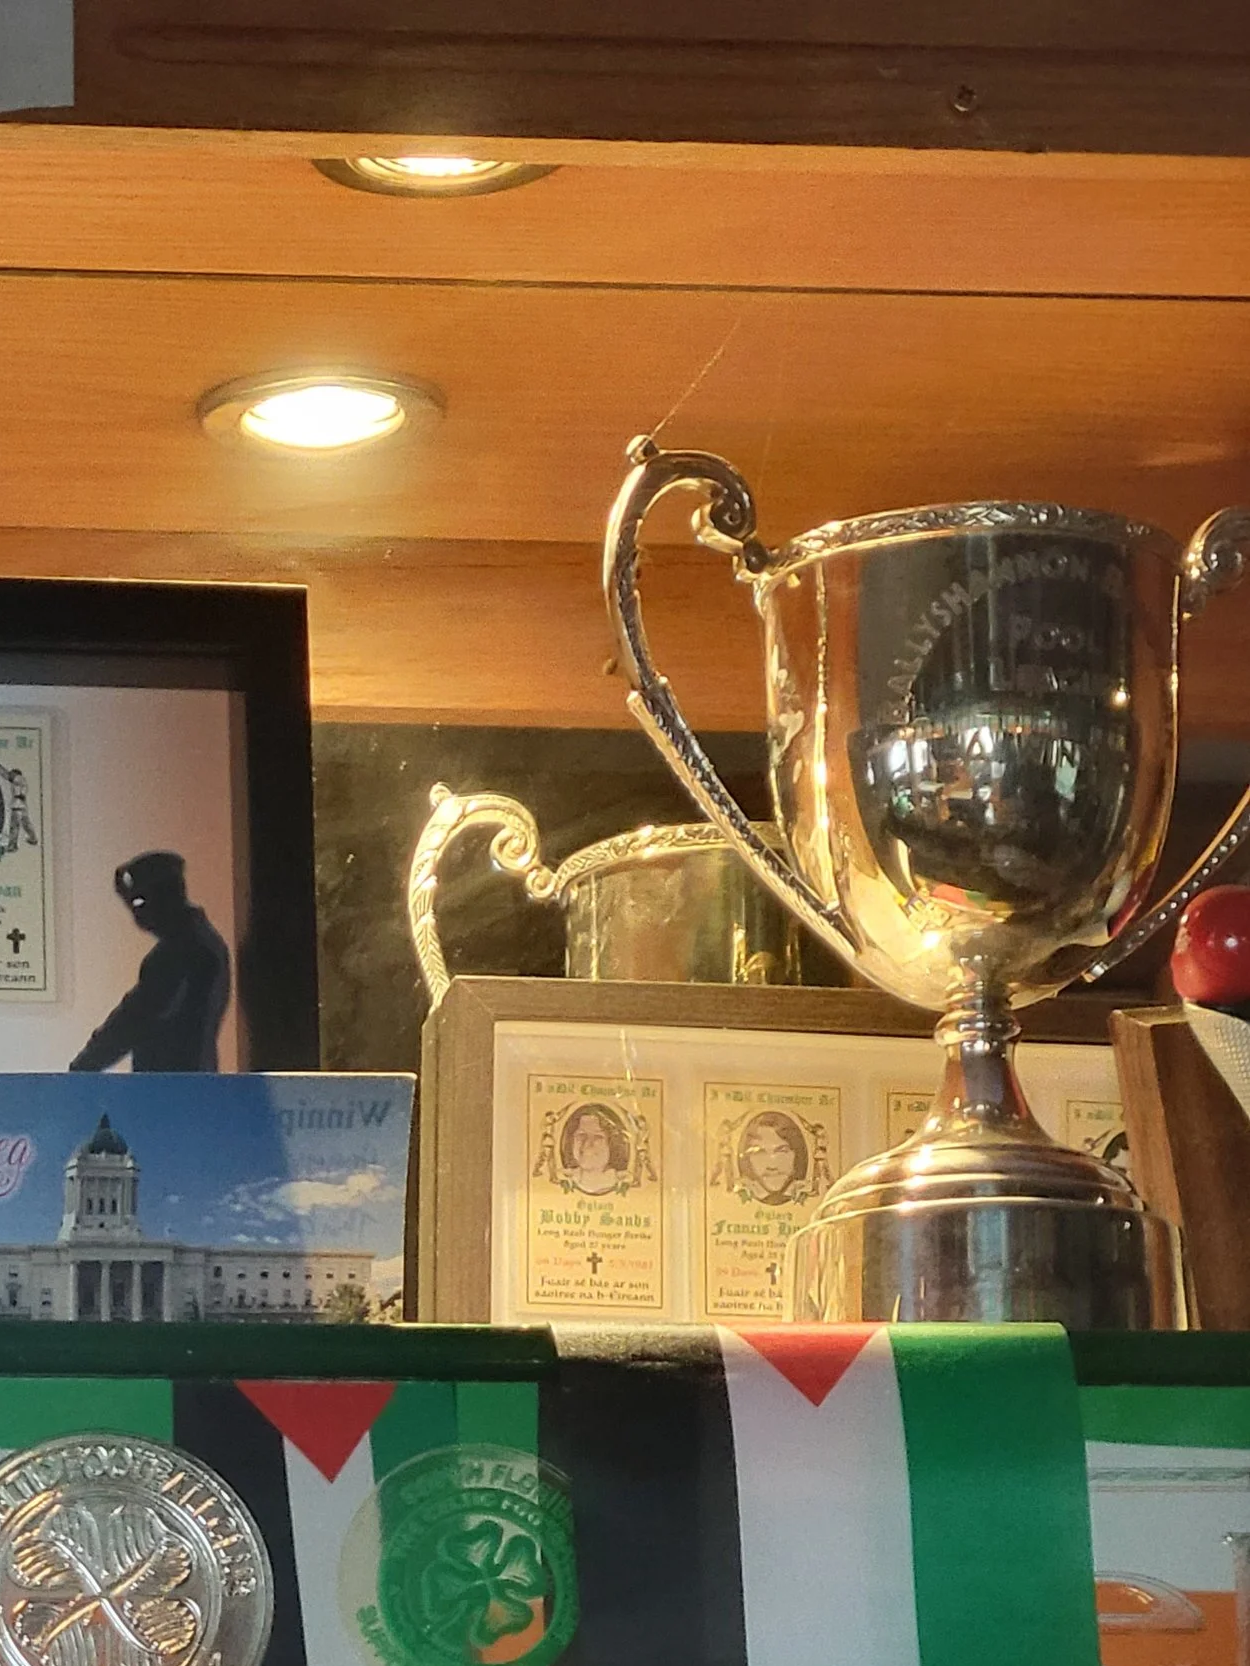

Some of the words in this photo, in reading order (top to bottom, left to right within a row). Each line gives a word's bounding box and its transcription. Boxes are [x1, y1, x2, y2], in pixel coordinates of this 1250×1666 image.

[540, 1209, 592, 1227] Bobby
[599, 1212, 652, 1228] Sands
[711, 1219, 769, 1235] Francis
